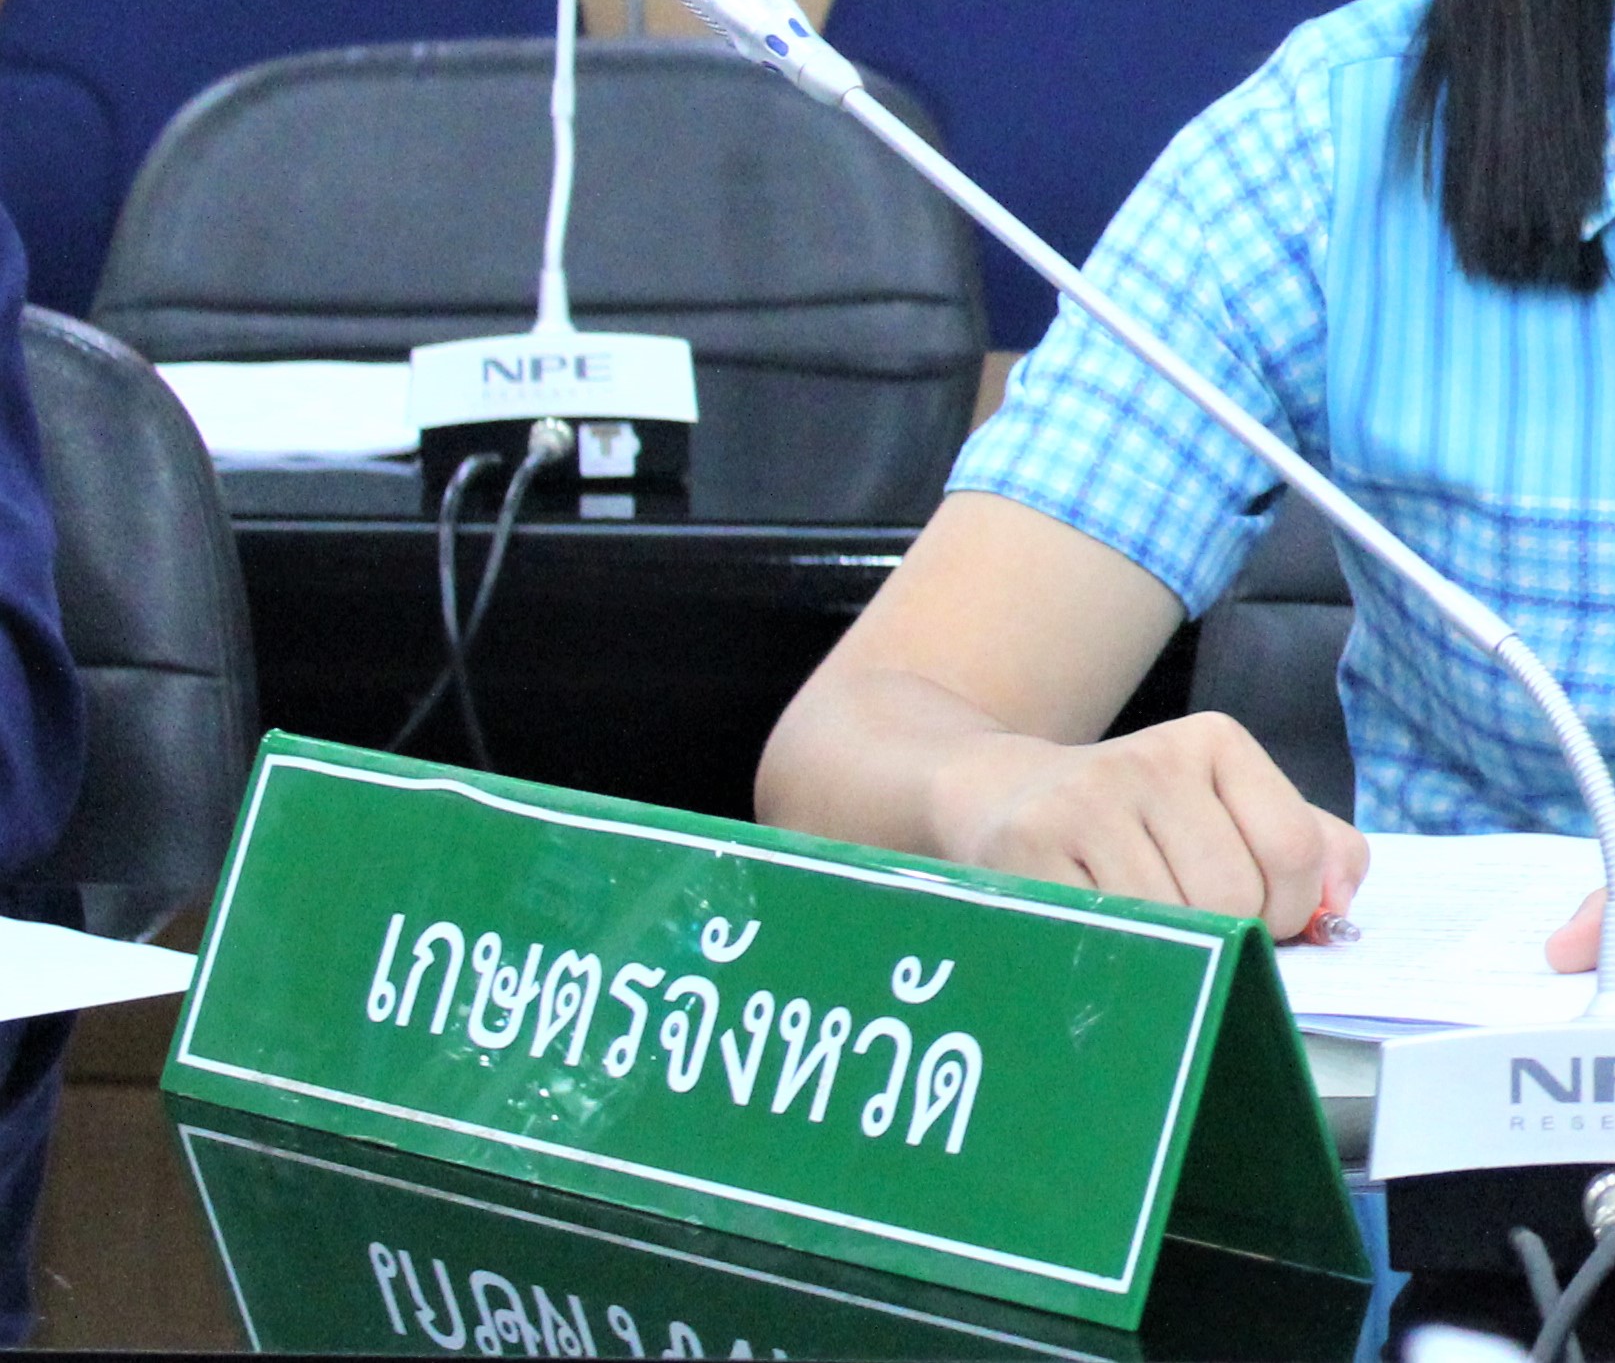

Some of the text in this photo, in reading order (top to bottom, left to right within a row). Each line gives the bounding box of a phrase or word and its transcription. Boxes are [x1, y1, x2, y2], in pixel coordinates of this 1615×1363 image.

[482, 353, 613, 384] NPE
[366, 913, 984, 1154] เกษตรจังหวัด
